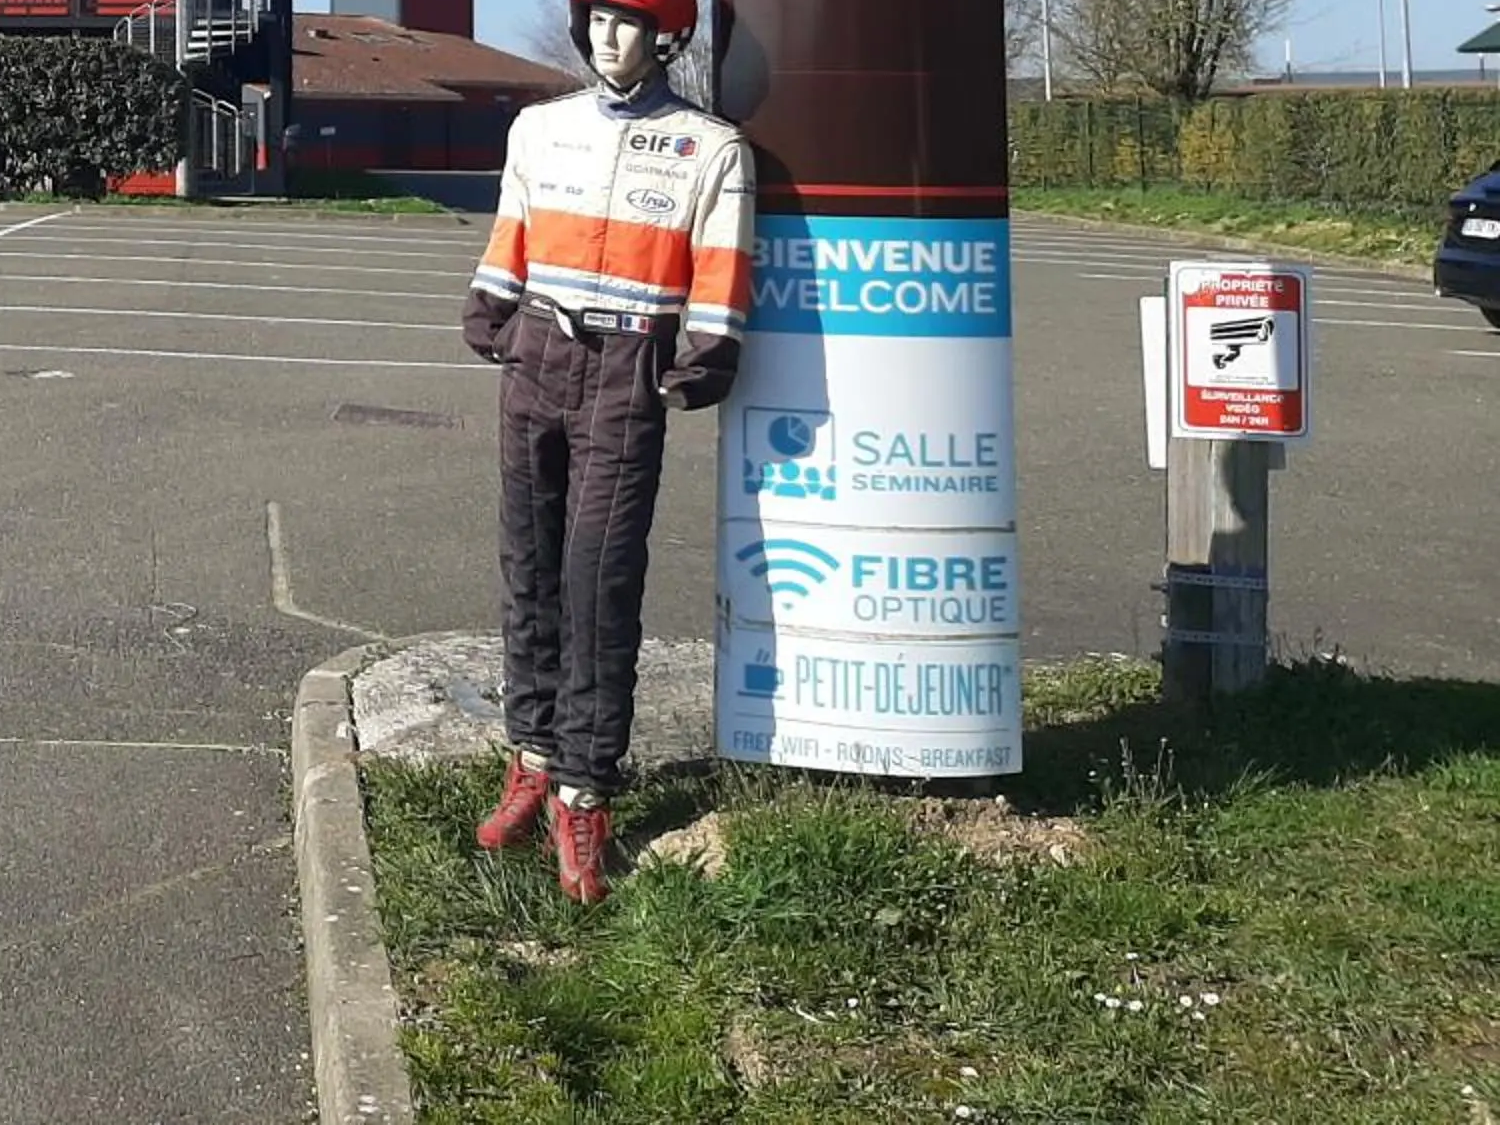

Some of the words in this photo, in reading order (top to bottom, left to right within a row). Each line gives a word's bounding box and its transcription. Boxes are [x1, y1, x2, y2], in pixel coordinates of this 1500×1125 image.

[629, 134, 672, 153] elf
[752, 238, 997, 273] BIENVENUE
[749, 277, 997, 314] WELCOME
[1215, 293, 1269, 308] PRIVÉE
[852, 431, 999, 467] SALLE
[852, 555, 1008, 591] FIBRE
[854, 595, 1007, 624] OPTIQUE
[782, 735, 819, 758] WIFI
[920, 747, 1012, 768] BREAKFAST
